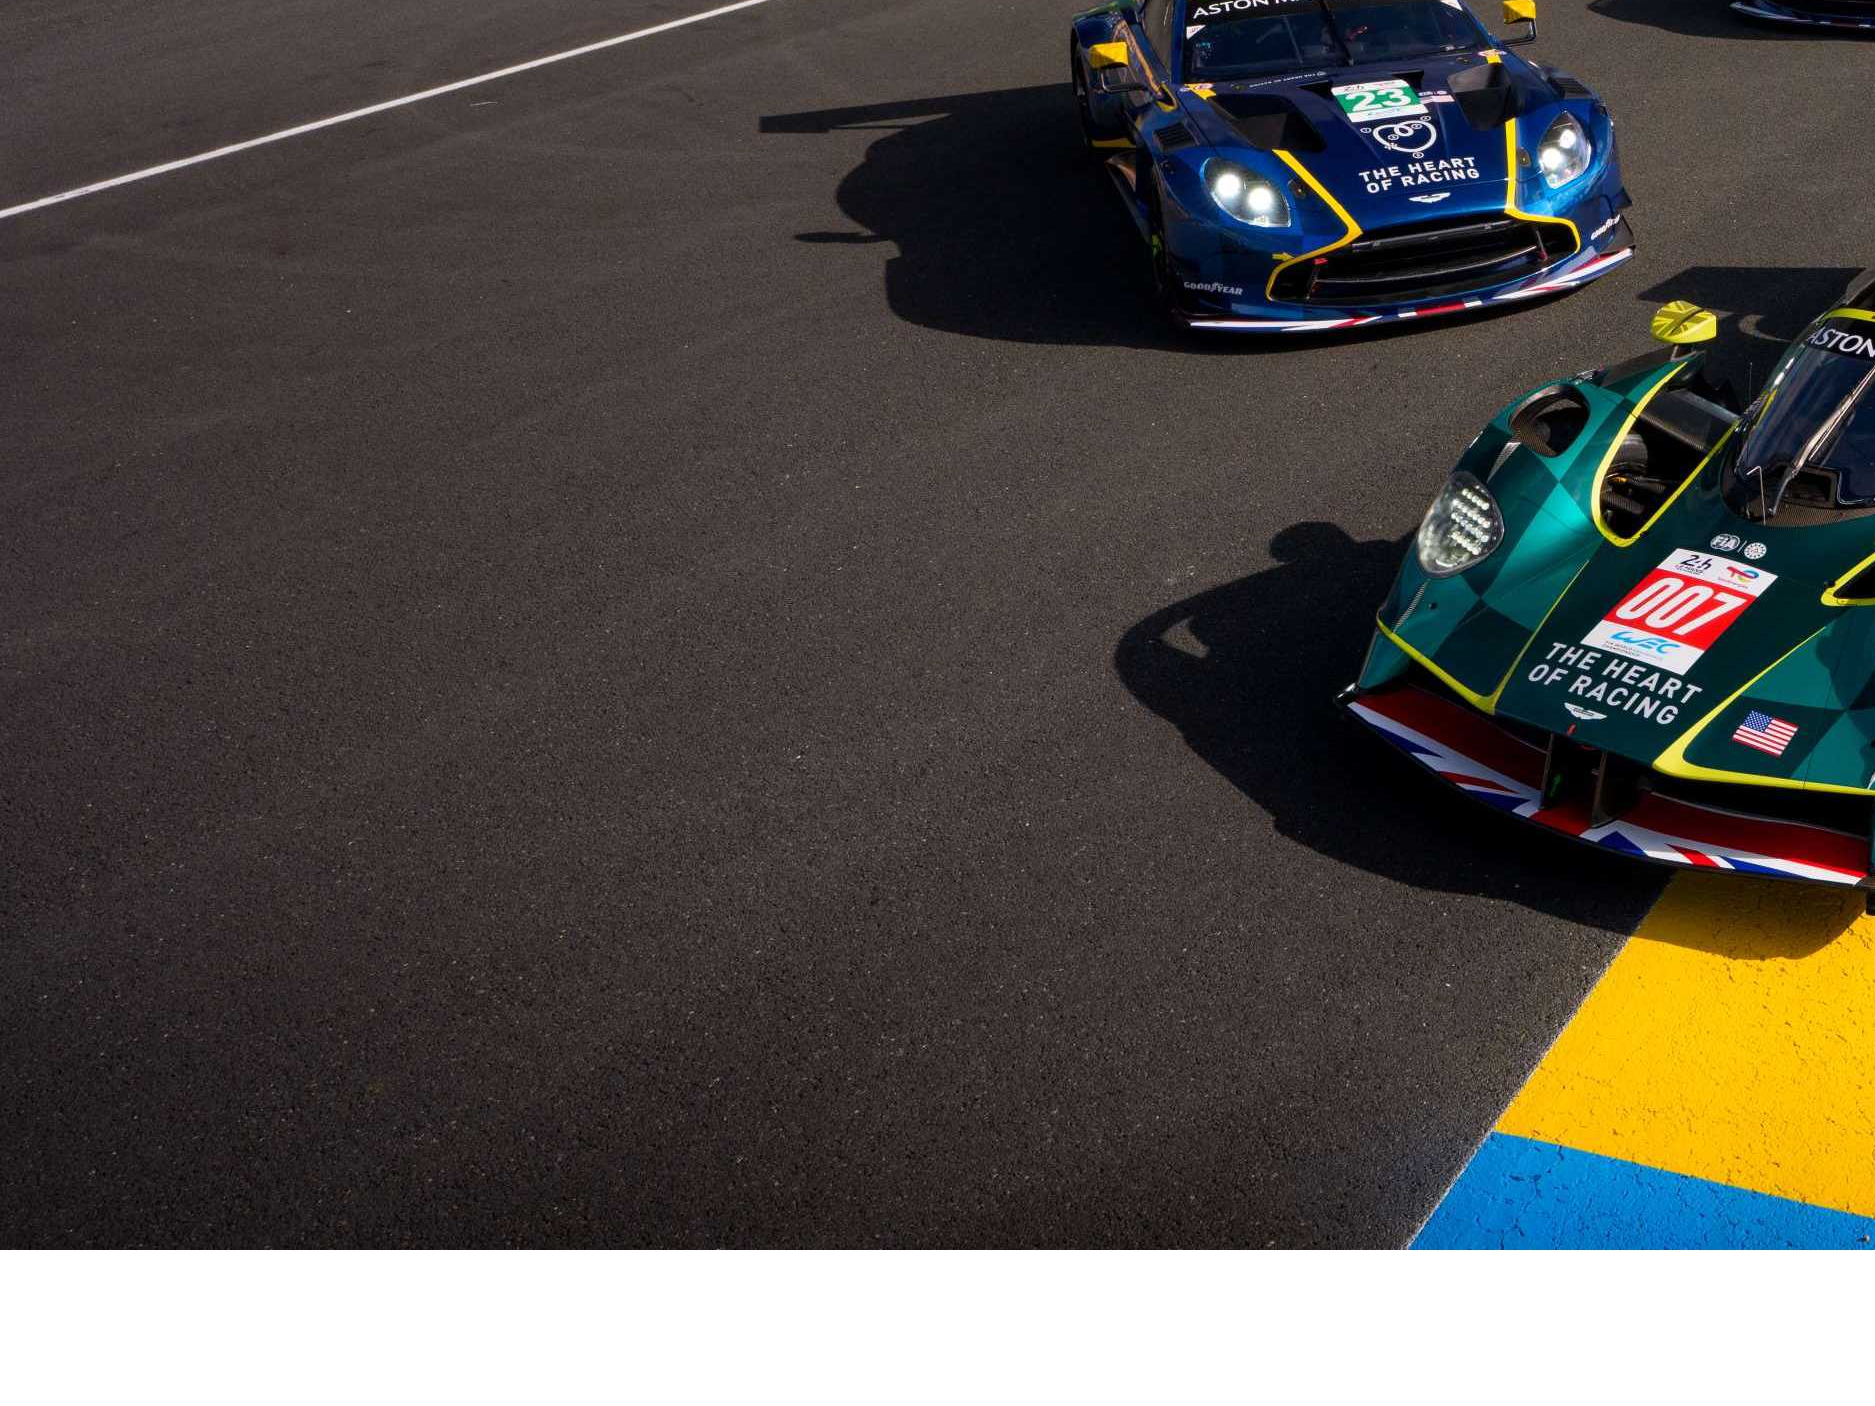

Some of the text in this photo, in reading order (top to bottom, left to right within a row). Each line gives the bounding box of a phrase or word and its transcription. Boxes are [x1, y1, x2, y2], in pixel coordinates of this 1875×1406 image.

[1345, 86, 1411, 112] 23
[1358, 156, 1475, 182] THE HEART
[1366, 168, 1480, 194] OF RACING
[1184, 281, 1243, 296] GOODYEAR
[1615, 577, 1748, 636] 007
[1611, 630, 1681, 654] WEC
[1545, 642, 1703, 704] THE HEART
[1527, 663, 1680, 725] OF RACING
